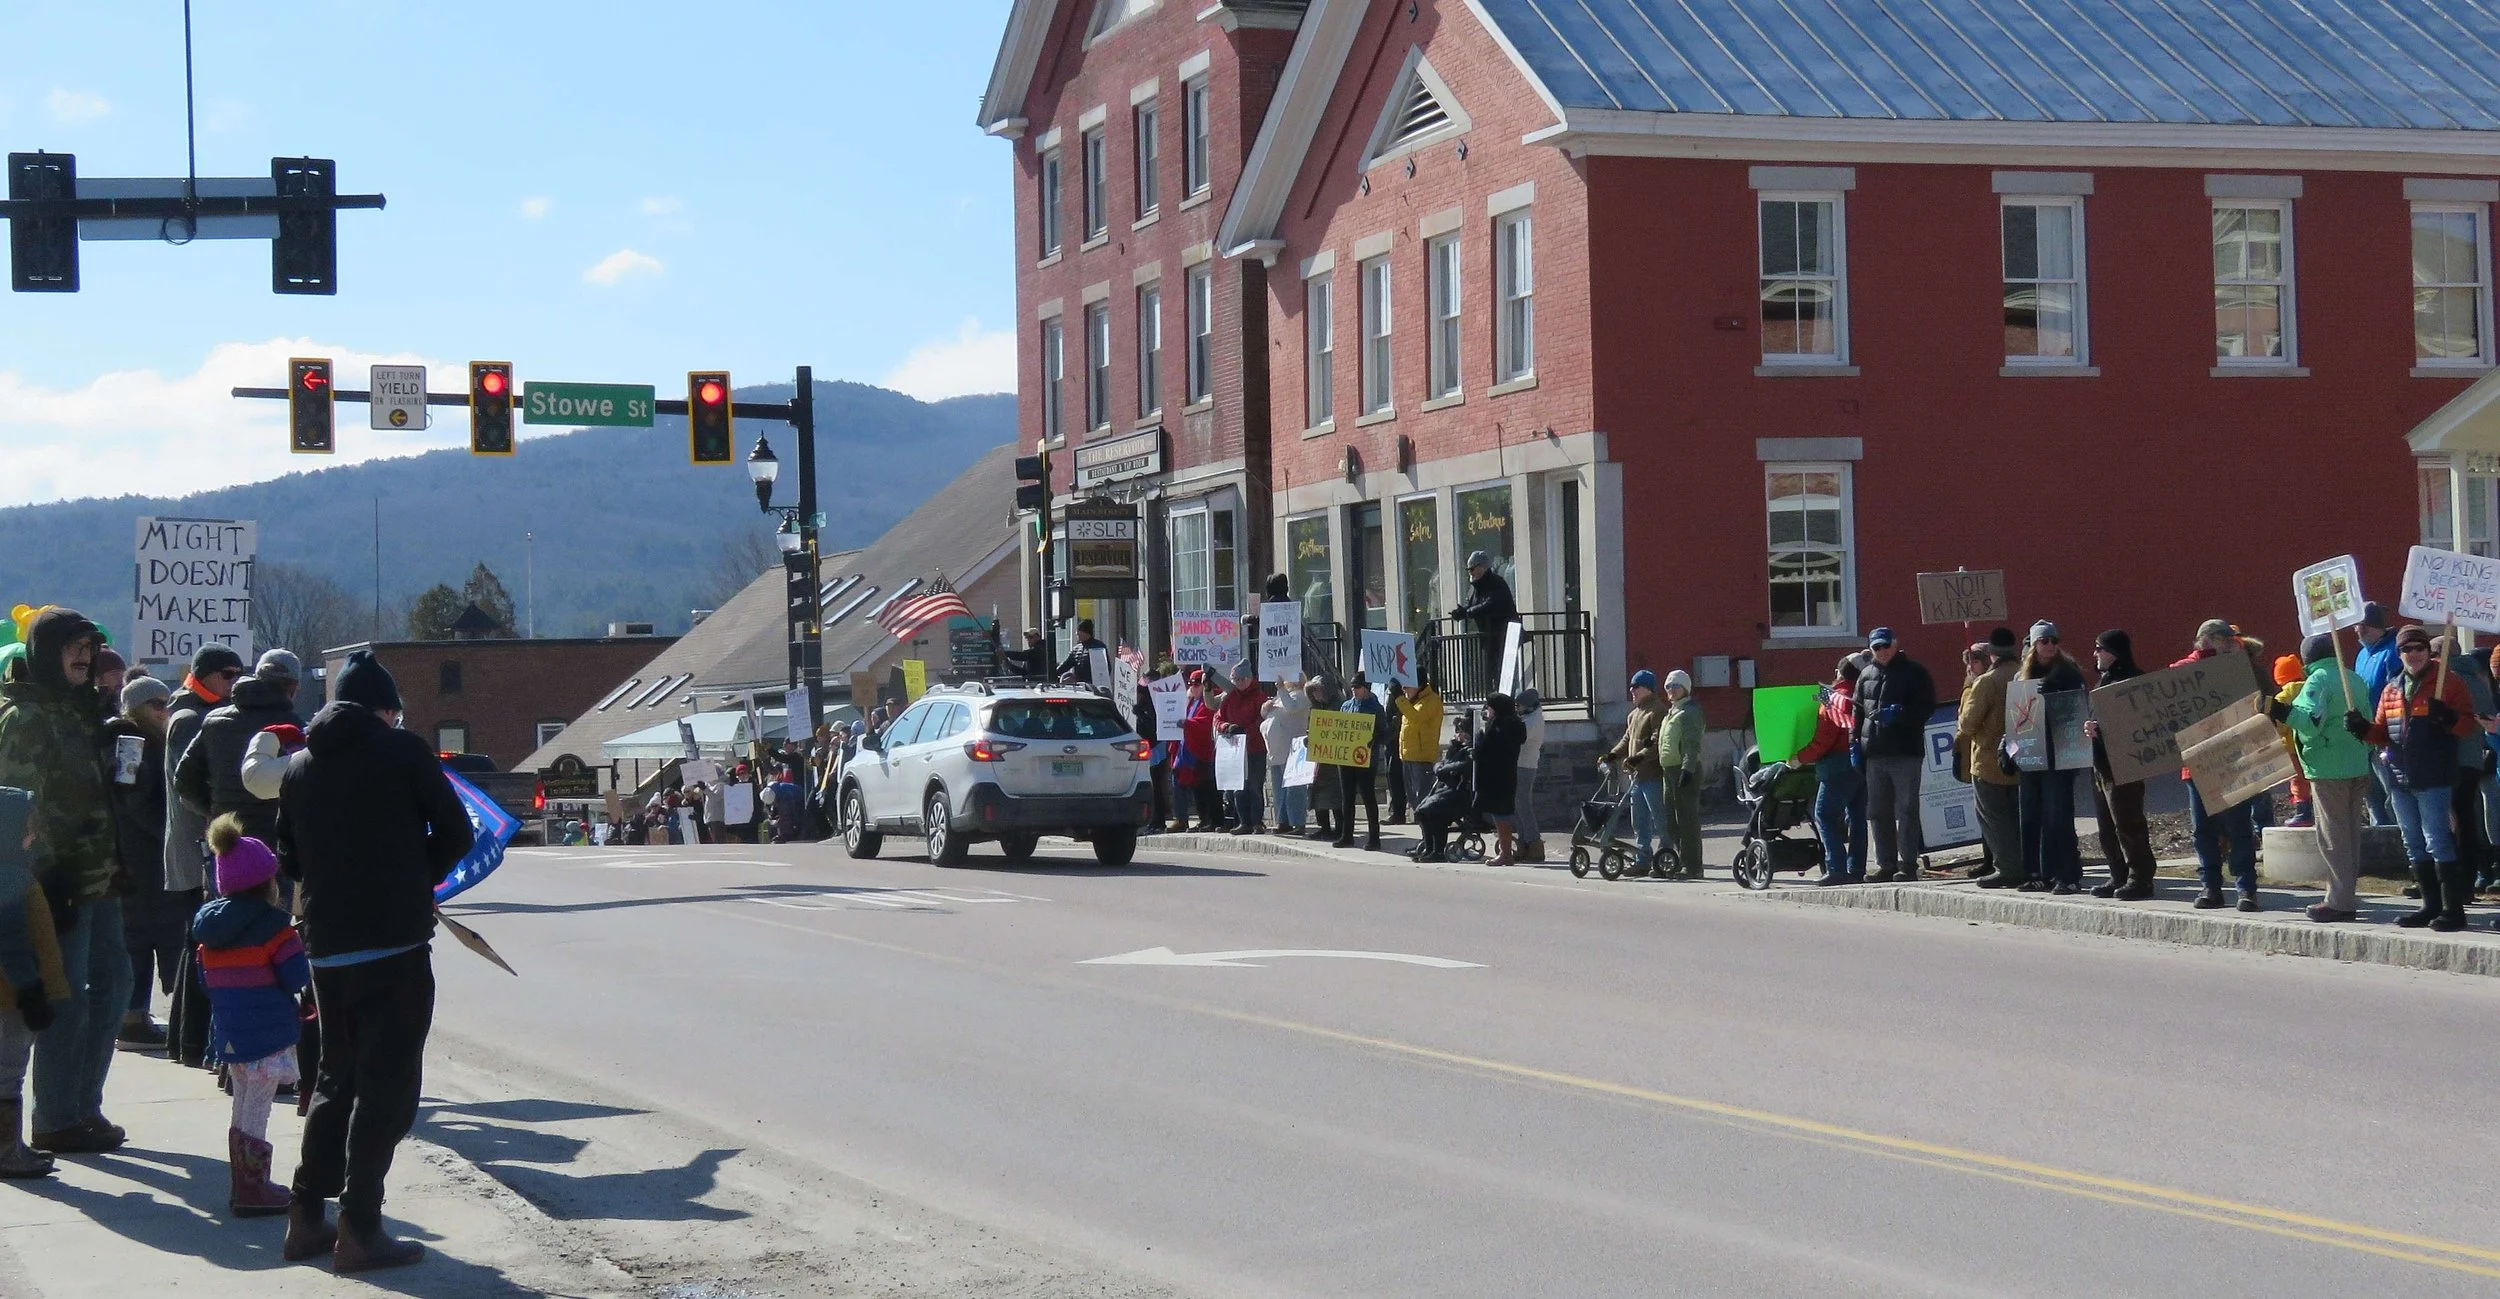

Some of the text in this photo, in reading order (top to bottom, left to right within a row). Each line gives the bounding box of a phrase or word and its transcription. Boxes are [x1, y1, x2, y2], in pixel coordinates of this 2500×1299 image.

[377, 371, 420, 380] LEFT TURN
[379, 382, 419, 395] YIELD
[531, 391, 647, 418] Stowe St
[1087, 439, 1146, 462] THE RESERVOIR
[1124, 460, 1133, 470] TAP
[1133, 457, 1145, 469] ROOM
[1093, 522, 1127, 537] SLR
[140, 522, 245, 555] MIGHT
[2424, 585, 2447, 599] WE
[138, 593, 253, 623] MAKE IT
[1932, 598, 1992, 618] KINGS
[2415, 598, 2496, 622] OUR COUNTRY
[1180, 618, 1233, 635] HANDS OFF
[1266, 624, 1289, 636] WHEN
[1183, 636, 1201, 646] OUR
[1178, 648, 1208, 661] RIGHTS
[1266, 647, 1288, 659] STAY
[2115, 670, 2205, 710] TRUMP
[2155, 690, 2222, 721] NEEDS
[1316, 717, 1372, 732] END THE REIGN
[1320, 730, 1330, 739] OF
[1332, 730, 1354, 742] SPITE
[1313, 744, 1350, 761] MALICE
[1931, 732, 1954, 765] P
